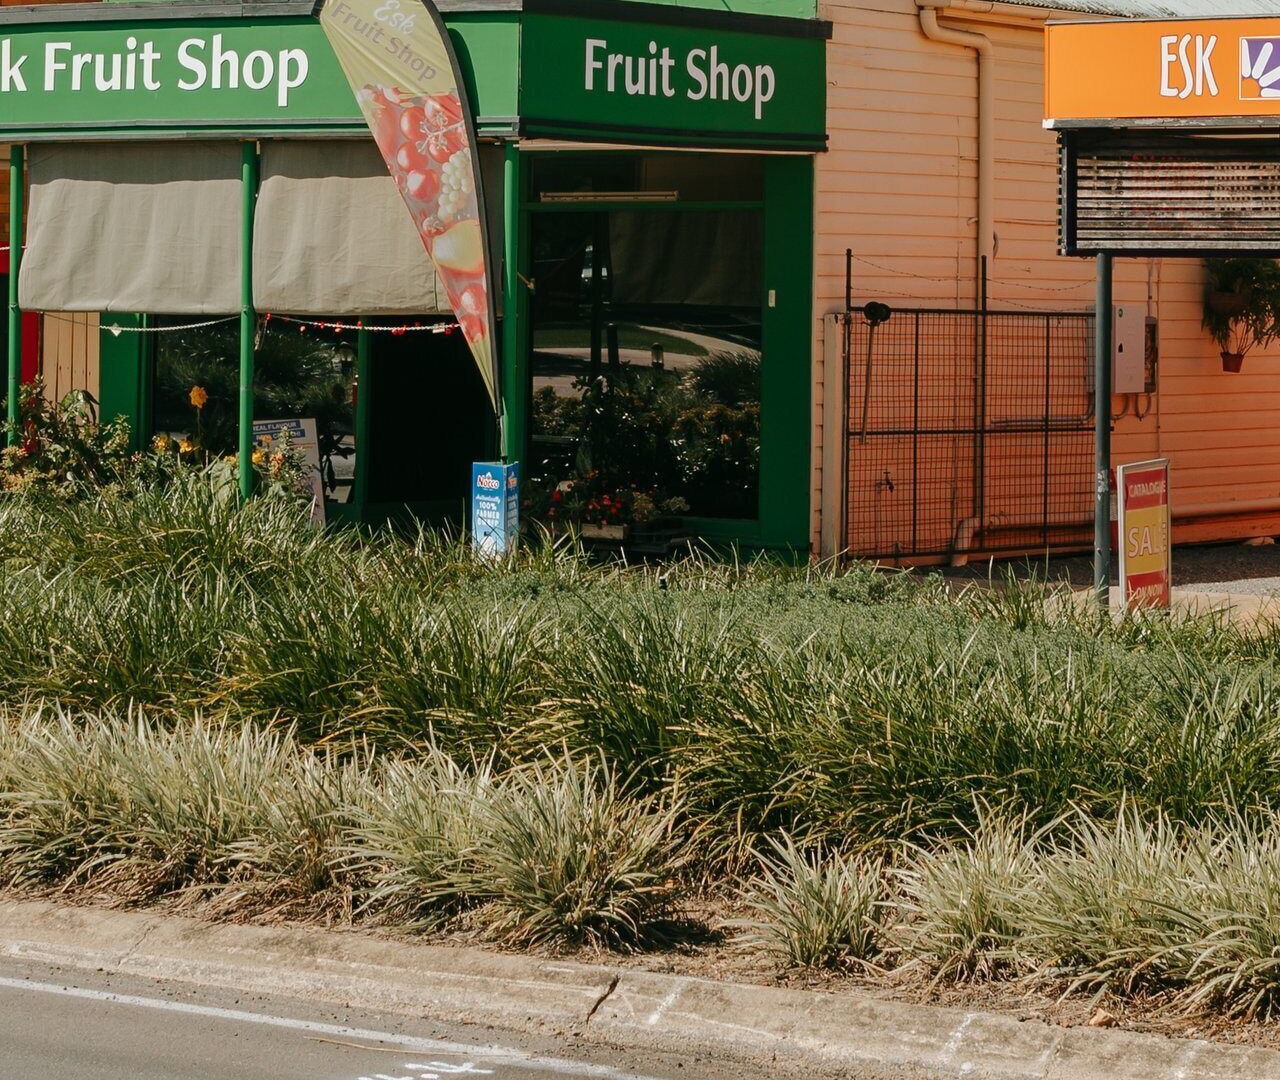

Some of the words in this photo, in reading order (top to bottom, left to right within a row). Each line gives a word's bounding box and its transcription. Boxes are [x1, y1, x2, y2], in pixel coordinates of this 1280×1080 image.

[331, 2, 385, 44] Fruit
[384, 36, 438, 82] Shop
[373, 0, 417, 34] Esk
[44, 36, 161, 92] Fruit
[176, 33, 310, 108] Shop
[584, 38, 676, 98] Fruit
[685, 44, 776, 120] Shop
[1159, 33, 1219, 99] ESK
[1129, 481, 1165, 498] CATALOGUE
[1128, 522, 1167, 558] SALE
